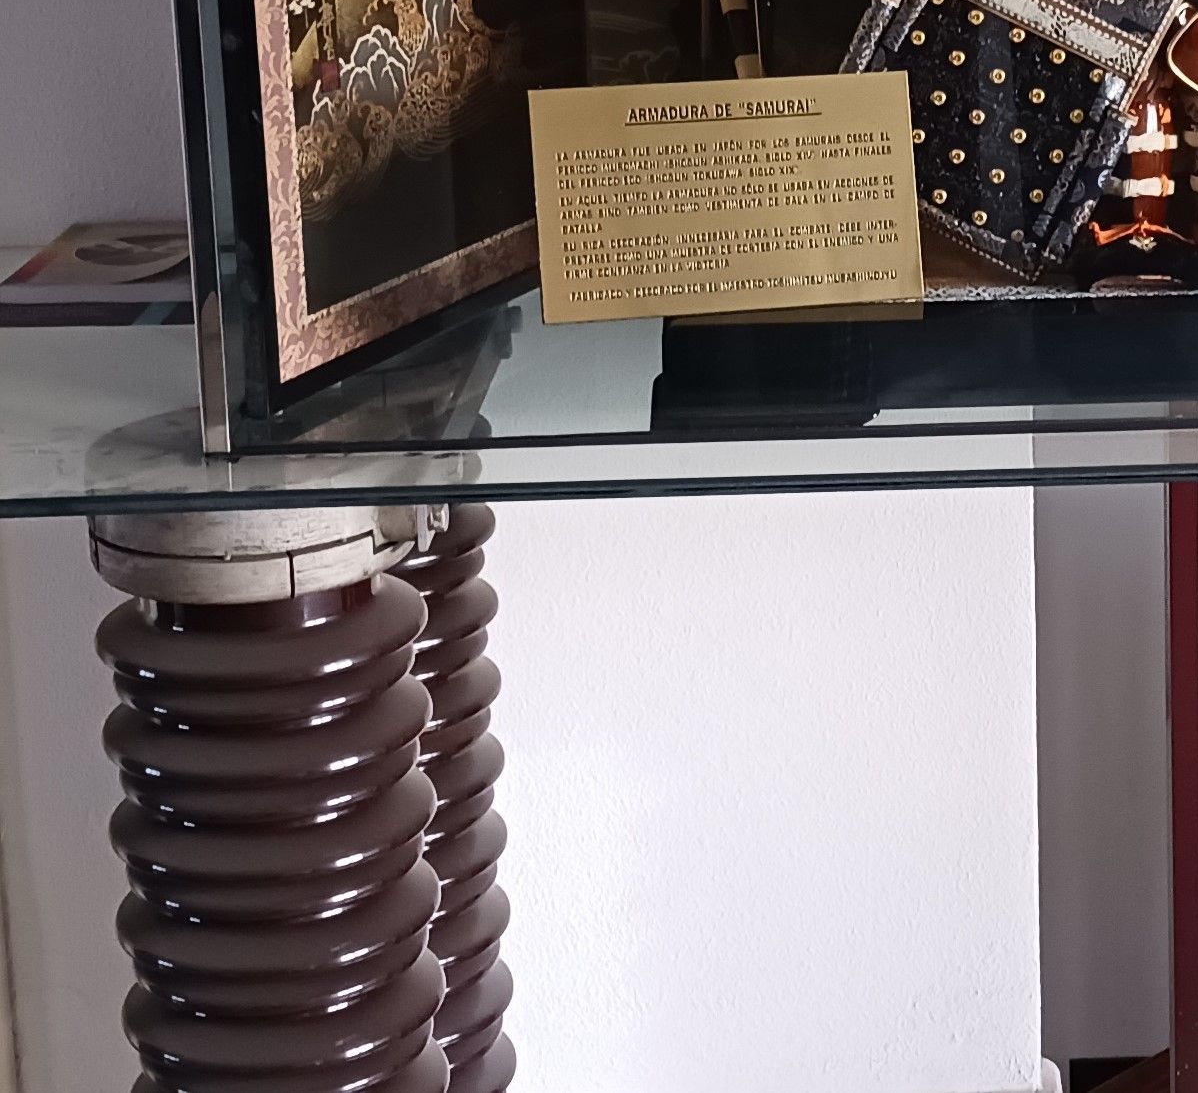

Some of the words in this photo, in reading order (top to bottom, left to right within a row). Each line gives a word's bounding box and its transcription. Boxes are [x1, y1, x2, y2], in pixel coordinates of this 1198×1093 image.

[628, 104, 708, 122] ARMADURA
[715, 103, 732, 118] DE
[739, 99, 817, 116] "SAMURAI"
[556, 150, 568, 161] LA
[574, 147, 626, 159] ARMADURA
[631, 145, 650, 156] FUE
[693, 142, 706, 153] EN
[750, 138, 766, 149] POR
[773, 137, 789, 148] LOS
[847, 132, 874, 144] DESDE
[881, 131, 890, 142] EL
[766, 151, 791, 162] SIGLO
[821, 148, 849, 159] HASTA
[855, 145, 891, 157] FINALES
[558, 178, 574, 189] DEL
[750, 166, 774, 177] SIGLO
[560, 195, 572, 206] EN
[577, 193, 607, 205] AQUEL
[614, 191, 647, 203] TIEMPO
[651, 190, 663, 200] LA
[667, 186, 719, 199] ARMADURA
[723, 185, 736, 196] NO
[769, 183, 778, 193] SE
[818, 179, 829, 190] EN
[834, 176, 878, 189] ACCIONES
[883, 175, 893, 186] DE
[599, 206, 620, 217] SINO
[673, 201, 699, 212] COMO
[705, 197, 761, 210] VESTIMENTA
[767, 196, 778, 206] DE
[784, 194, 808, 205] GALA
[813, 193, 825, 203] EN
[830, 192, 841, 202] EL
[847, 190, 879, 201] CAMPO
[883, 189, 894, 199] DE
[563, 241, 576, 251] SU
[582, 239, 604, 250] RICA
[744, 228, 767, 239] PARA
[772, 227, 783, 237] EL
[838, 222, 860, 233] DEBE
[615, 250, 641, 262] COMO
[646, 248, 667, 259] UNA
[671, 245, 715, 258] MUESTRA
[719, 244, 731, 254] DE
[784, 239, 803, 250] CON
[808, 238, 818, 248] EL
[821, 235, 863, 248] ENEMIGO
[867, 235, 873, 244] Y
[878, 233, 898, 244] UNA
[564, 268, 593, 279] FIRME
[596, 264, 650, 277] CONFIANZA
[654, 263, 667, 273] EN
[670, 262, 682, 272] LA
[570, 288, 622, 301] FABRICADO
[624, 287, 630, 298] Y
[634, 284, 683, 297] DECORADO
[685, 282, 704, 293] POR
[707, 282, 718, 292] EL
[721, 278, 763, 291] MAESTRO
